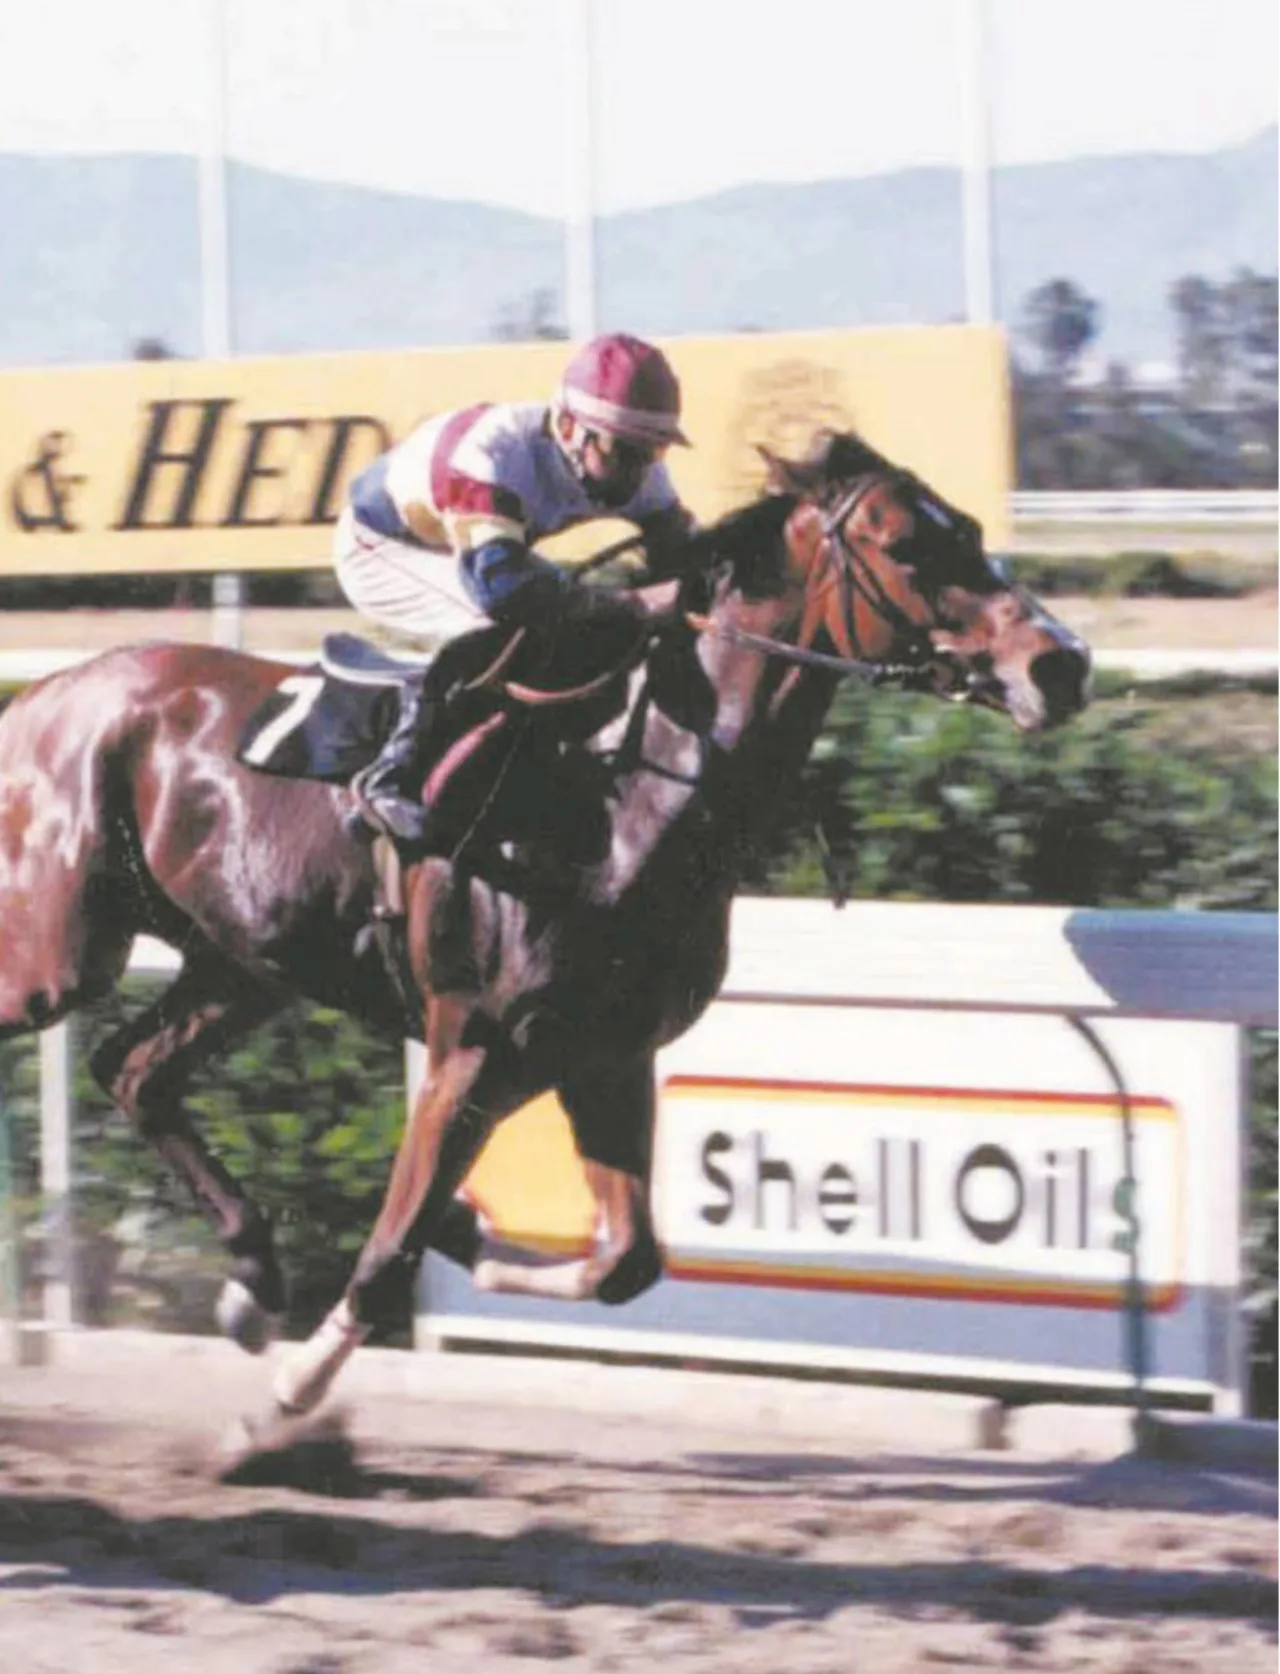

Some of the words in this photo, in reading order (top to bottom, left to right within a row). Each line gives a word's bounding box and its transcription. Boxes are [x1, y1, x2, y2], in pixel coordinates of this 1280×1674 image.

[11, 430, 86, 534] &
[108, 397, 394, 532] HED
[243, 676, 325, 767] 7
[698, 1130, 924, 1242] Shell
